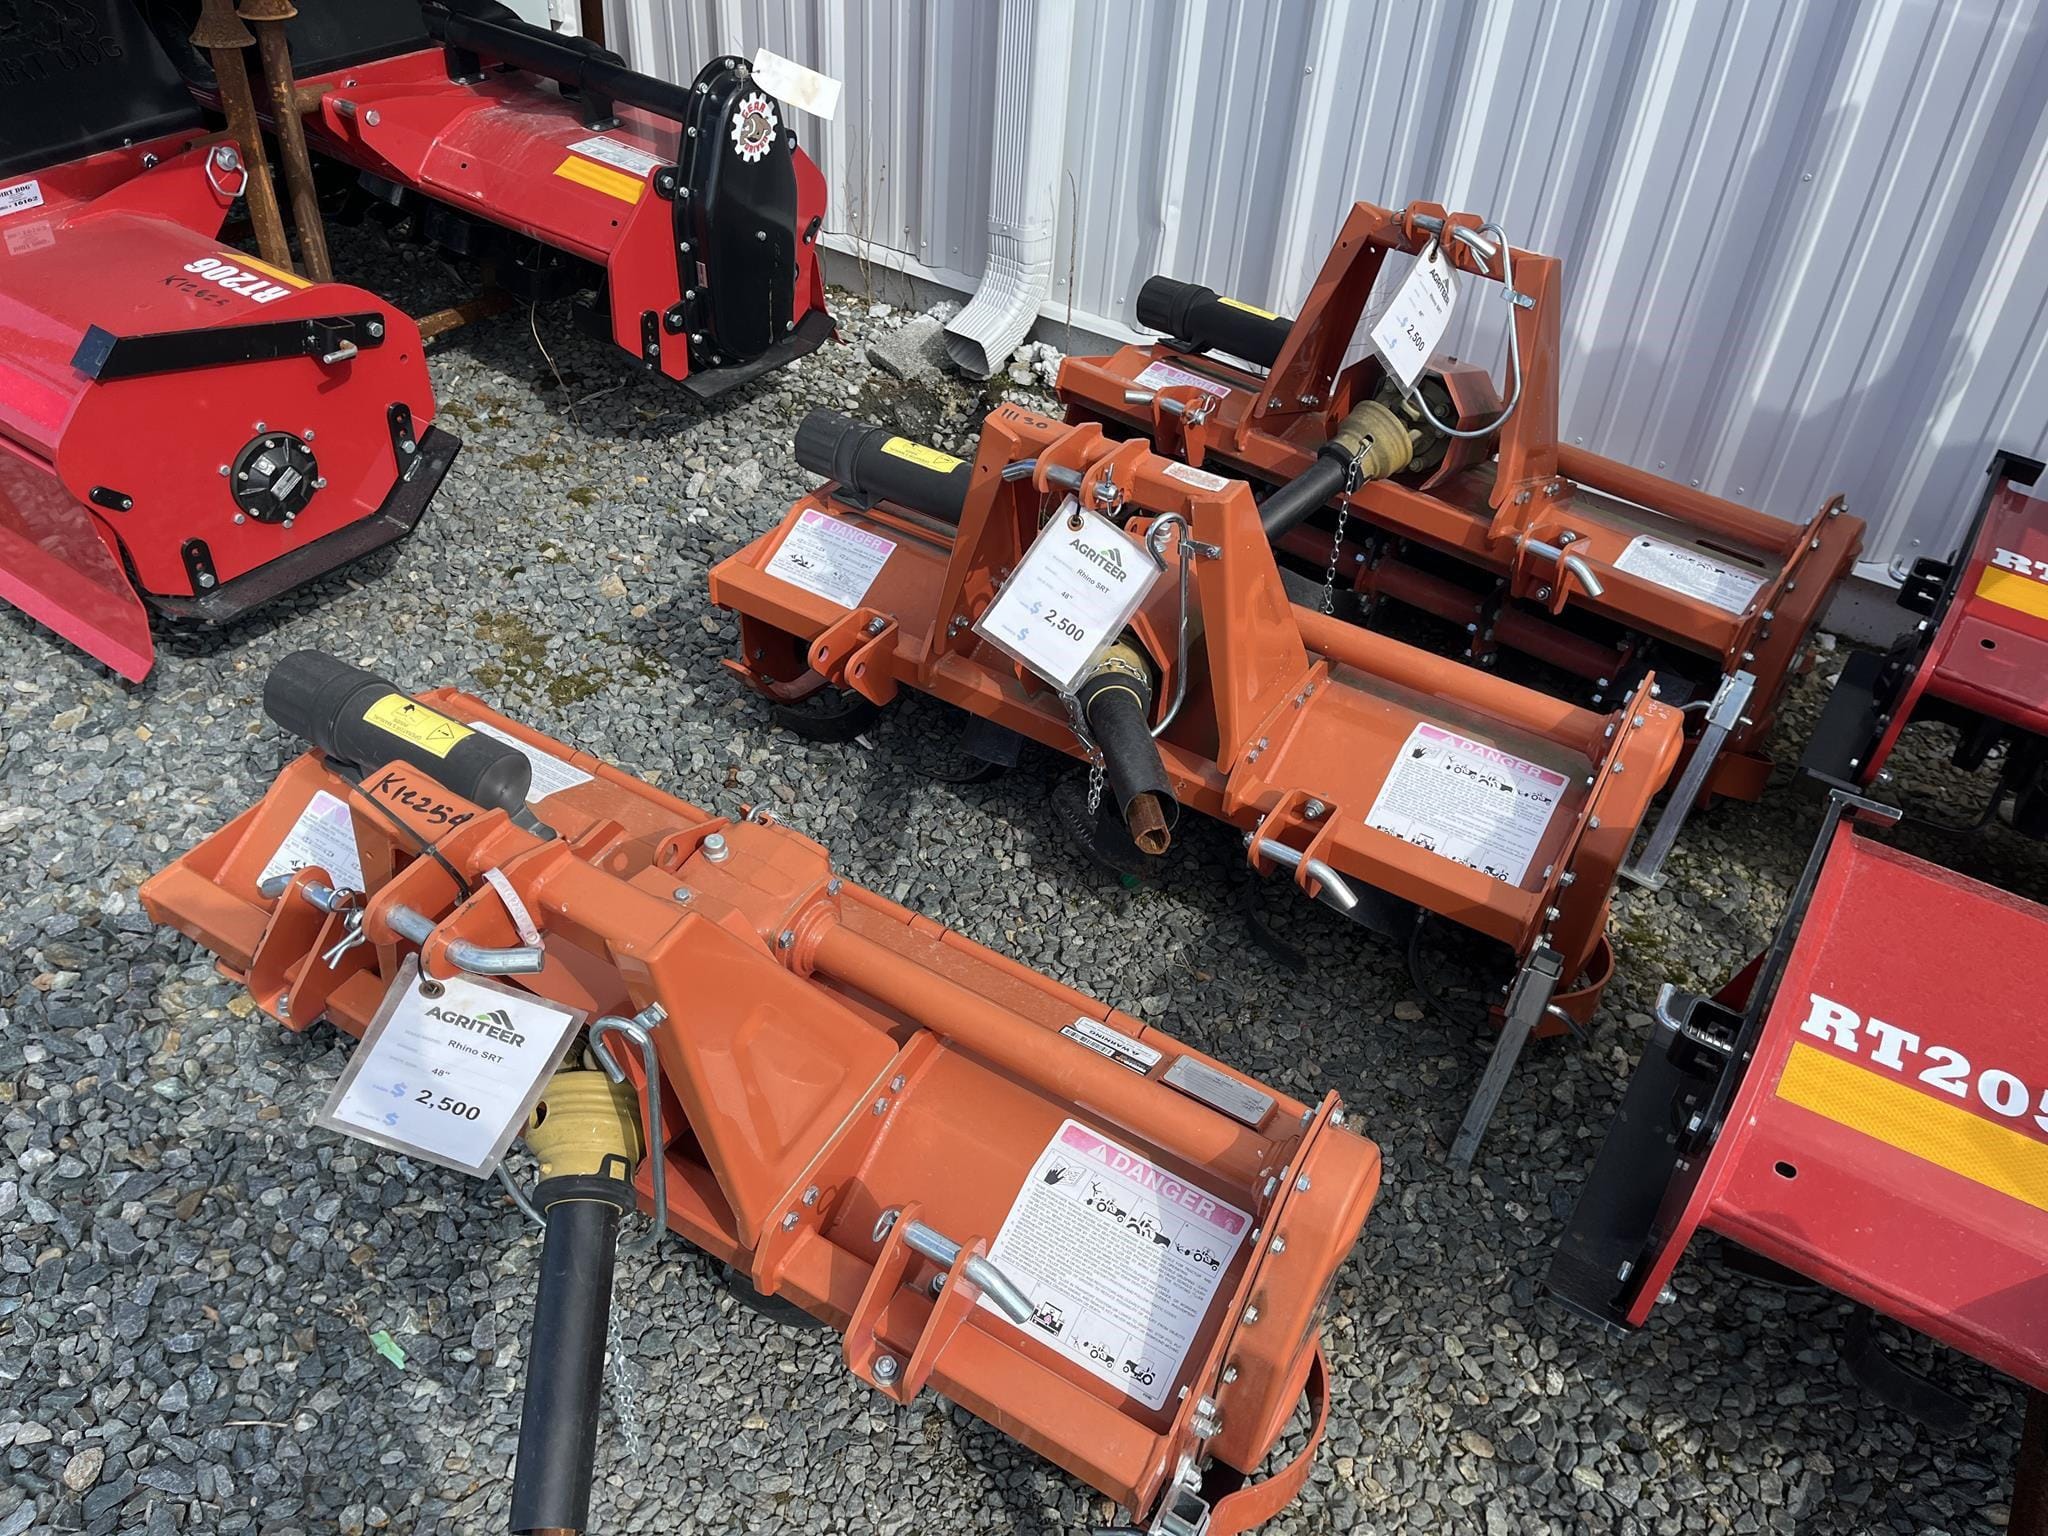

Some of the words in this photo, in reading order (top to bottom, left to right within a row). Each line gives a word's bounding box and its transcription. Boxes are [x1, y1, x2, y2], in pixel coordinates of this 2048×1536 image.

[741, 101, 766, 119] GEAR
[0, 189, 13, 198] IRT
[183, 258, 291, 303] RT206
[1406, 324, 1425, 352] 2,500
[829, 521, 882, 550] DANGER
[1069, 538, 1127, 583] AGRITEER
[1076, 568, 1095, 585] Rhino
[1095, 581, 1111, 595] SRT
[1044, 609, 1085, 642] 2,500
[1459, 741, 1543, 778] DANGER
[424, 1006, 525, 1048] AGRITEER
[448, 1039, 479, 1056] Rhino
[480, 1051, 504, 1064] SRT
[1800, 992, 2048, 1134] RT20
[415, 1089, 481, 1121] 2,500
[1110, 1152, 1217, 1220] DANGER
